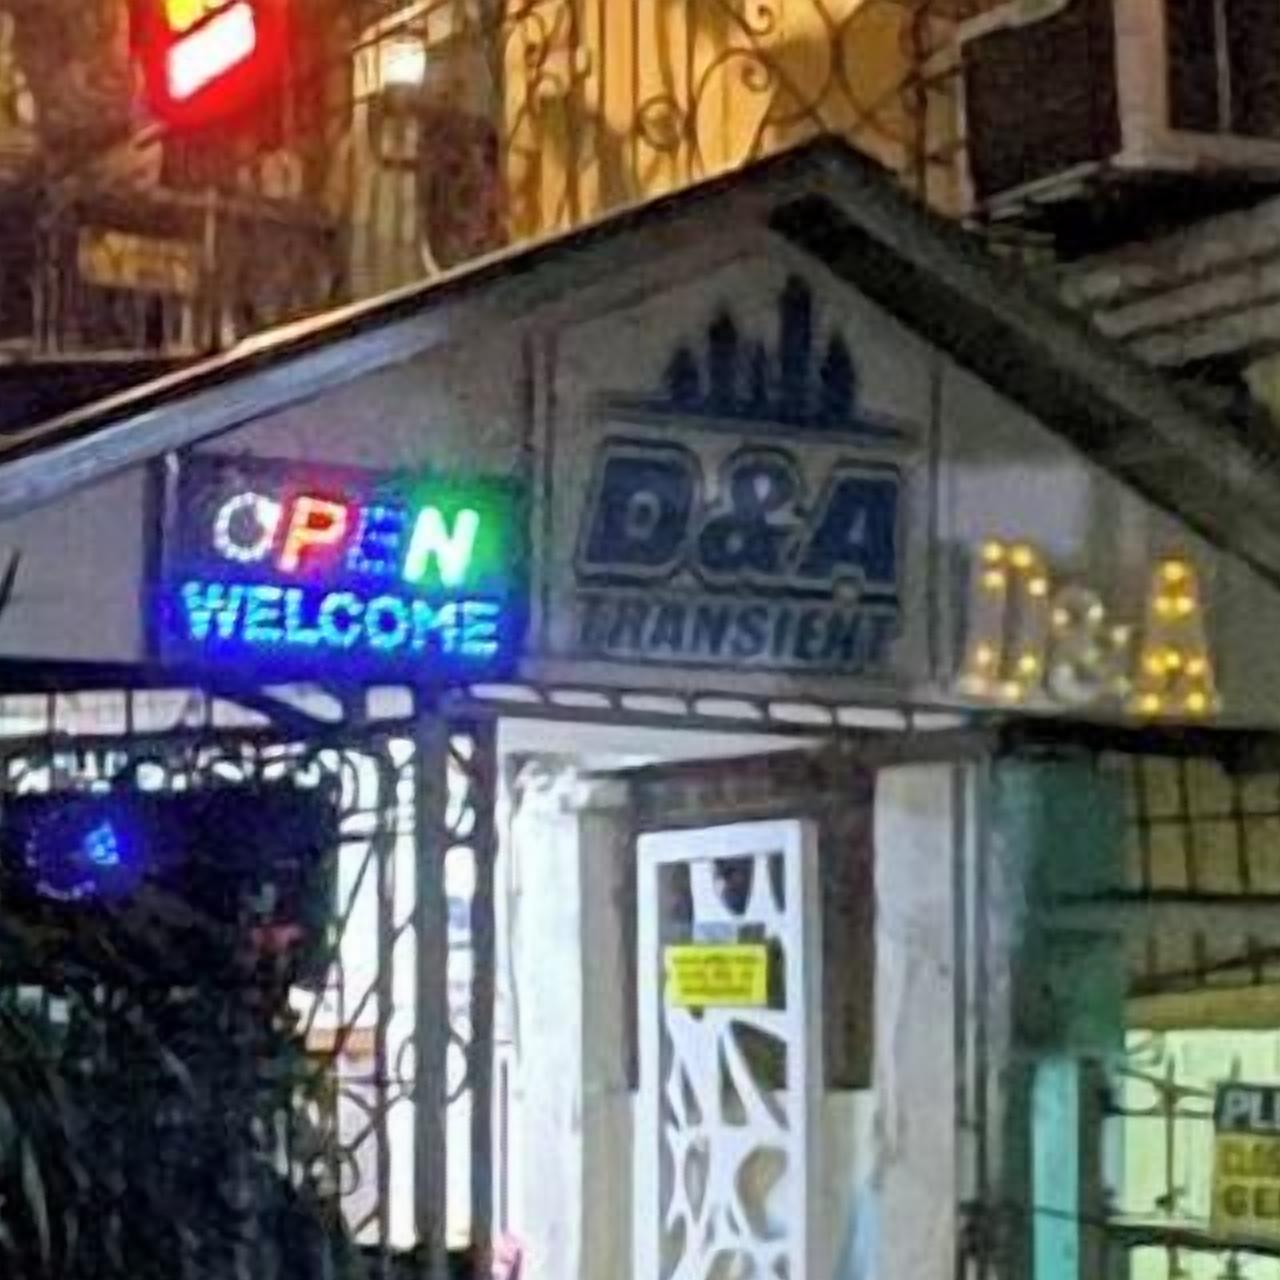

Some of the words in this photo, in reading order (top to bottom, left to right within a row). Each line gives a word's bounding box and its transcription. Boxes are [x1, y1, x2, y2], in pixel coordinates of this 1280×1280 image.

[213, 492, 480, 587] OPEN
[580, 440, 898, 598] D&A
[182, 581, 500, 657] WELCOME
